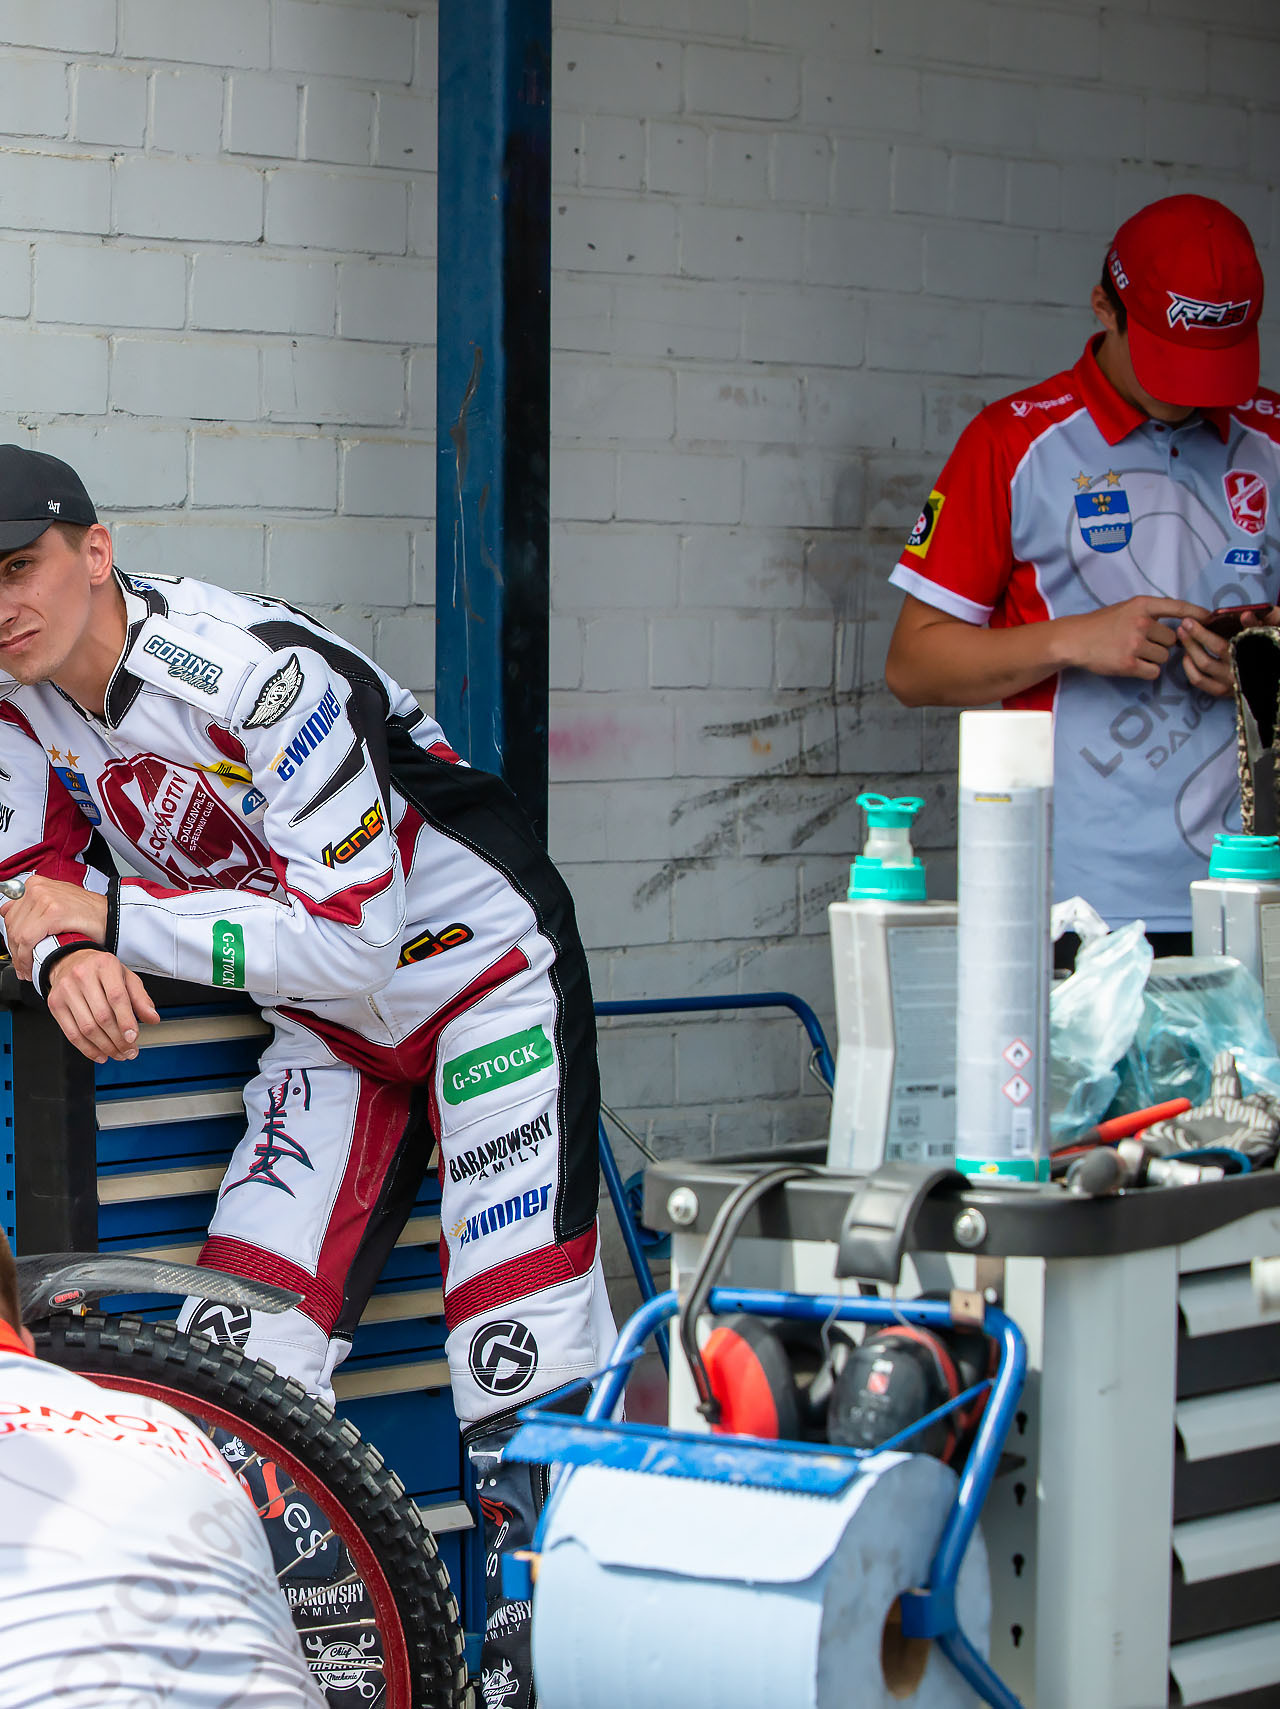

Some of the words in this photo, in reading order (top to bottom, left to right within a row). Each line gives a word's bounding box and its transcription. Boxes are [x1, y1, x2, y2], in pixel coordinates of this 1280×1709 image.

[143, 635, 223, 686] GORINA
[222, 932, 236, 987] G-STOCK
[452, 1042, 541, 1091] G-STOCK
[449, 1112, 553, 1184] BARANOWSKY
